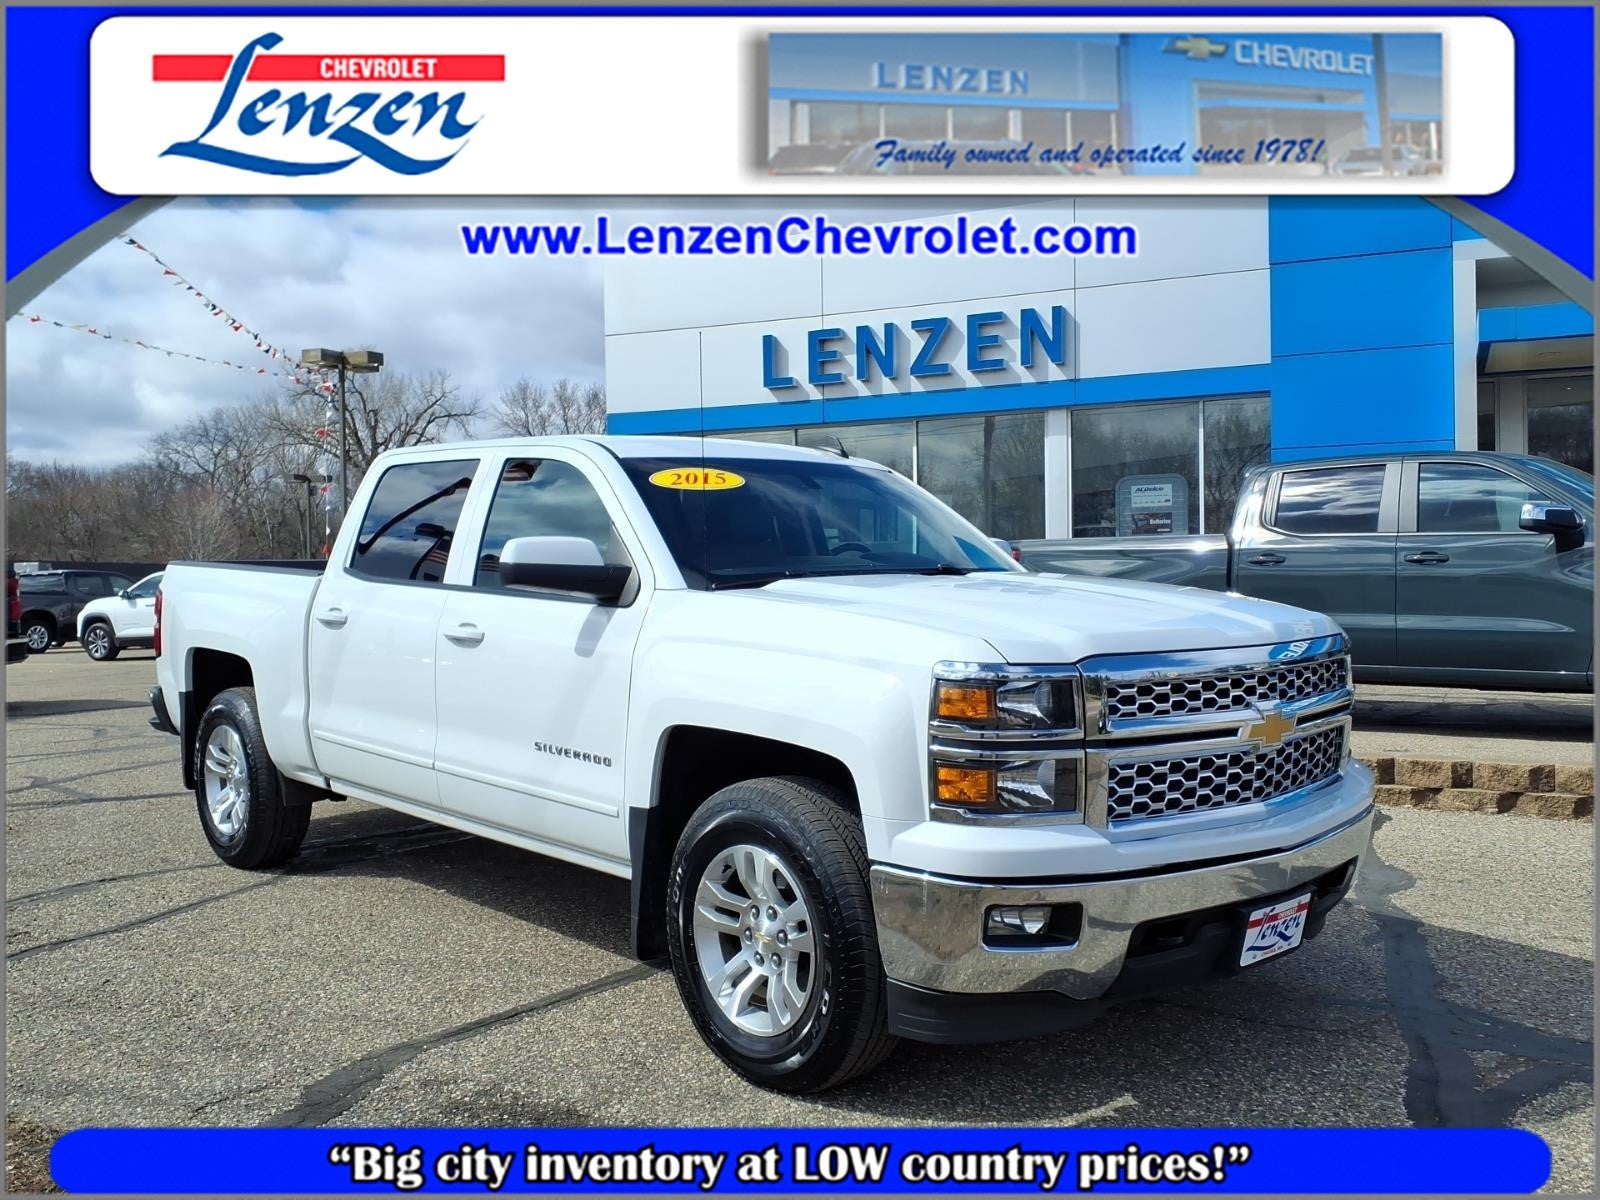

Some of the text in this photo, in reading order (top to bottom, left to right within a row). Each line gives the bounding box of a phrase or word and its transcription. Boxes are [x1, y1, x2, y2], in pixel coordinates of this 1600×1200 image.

[762, 305, 1066, 389] LENZEN
[670, 472, 727, 486] 2015
[534, 741, 612, 768] SILVERADO
[1245, 907, 1302, 952] Lenzen
